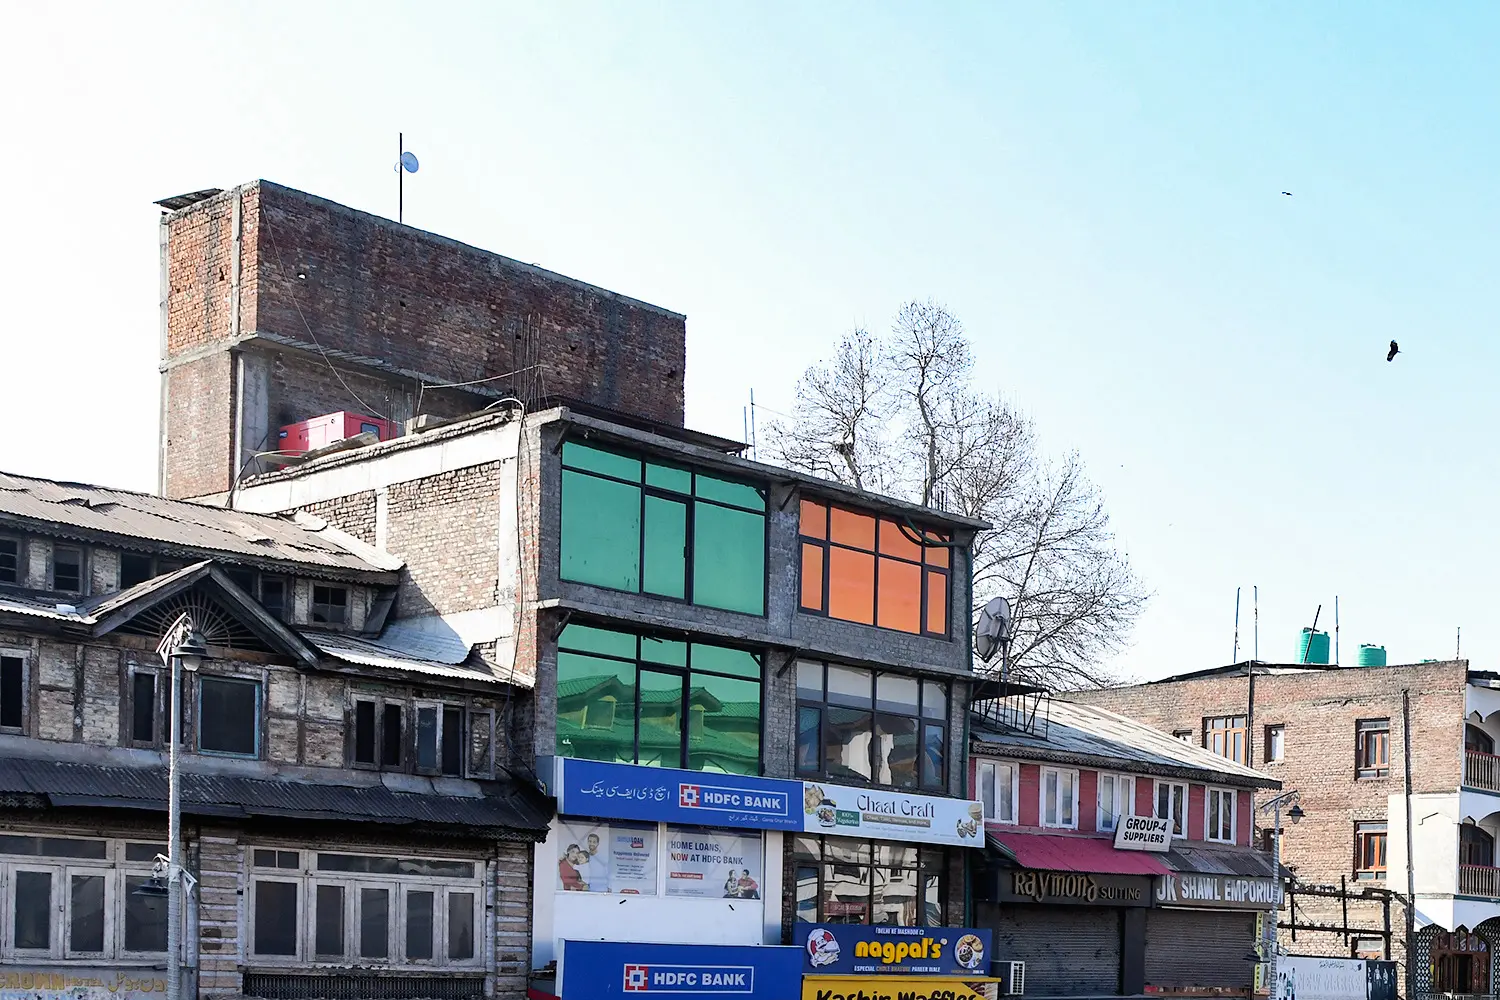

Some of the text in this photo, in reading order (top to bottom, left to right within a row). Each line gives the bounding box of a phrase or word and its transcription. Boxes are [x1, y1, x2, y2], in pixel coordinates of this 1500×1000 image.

[704, 792, 781, 809] HDFC BANK
[856, 795, 935, 818] Chaat Craft
[1126, 818, 1167, 833] GROUP-4
[1123, 831, 1165, 844] SUPPLIERS
[670, 840, 722, 853] HOME LOANS,
[670, 852, 744, 865] NOW AT HDFC BANK
[1100, 885, 1141, 900] SUITING
[1156, 875, 1177, 901] JK
[1181, 876, 1221, 901] SHAWL
[855, 938, 942, 964] nagpal's
[654, 972, 746, 986] HDFC BANK
